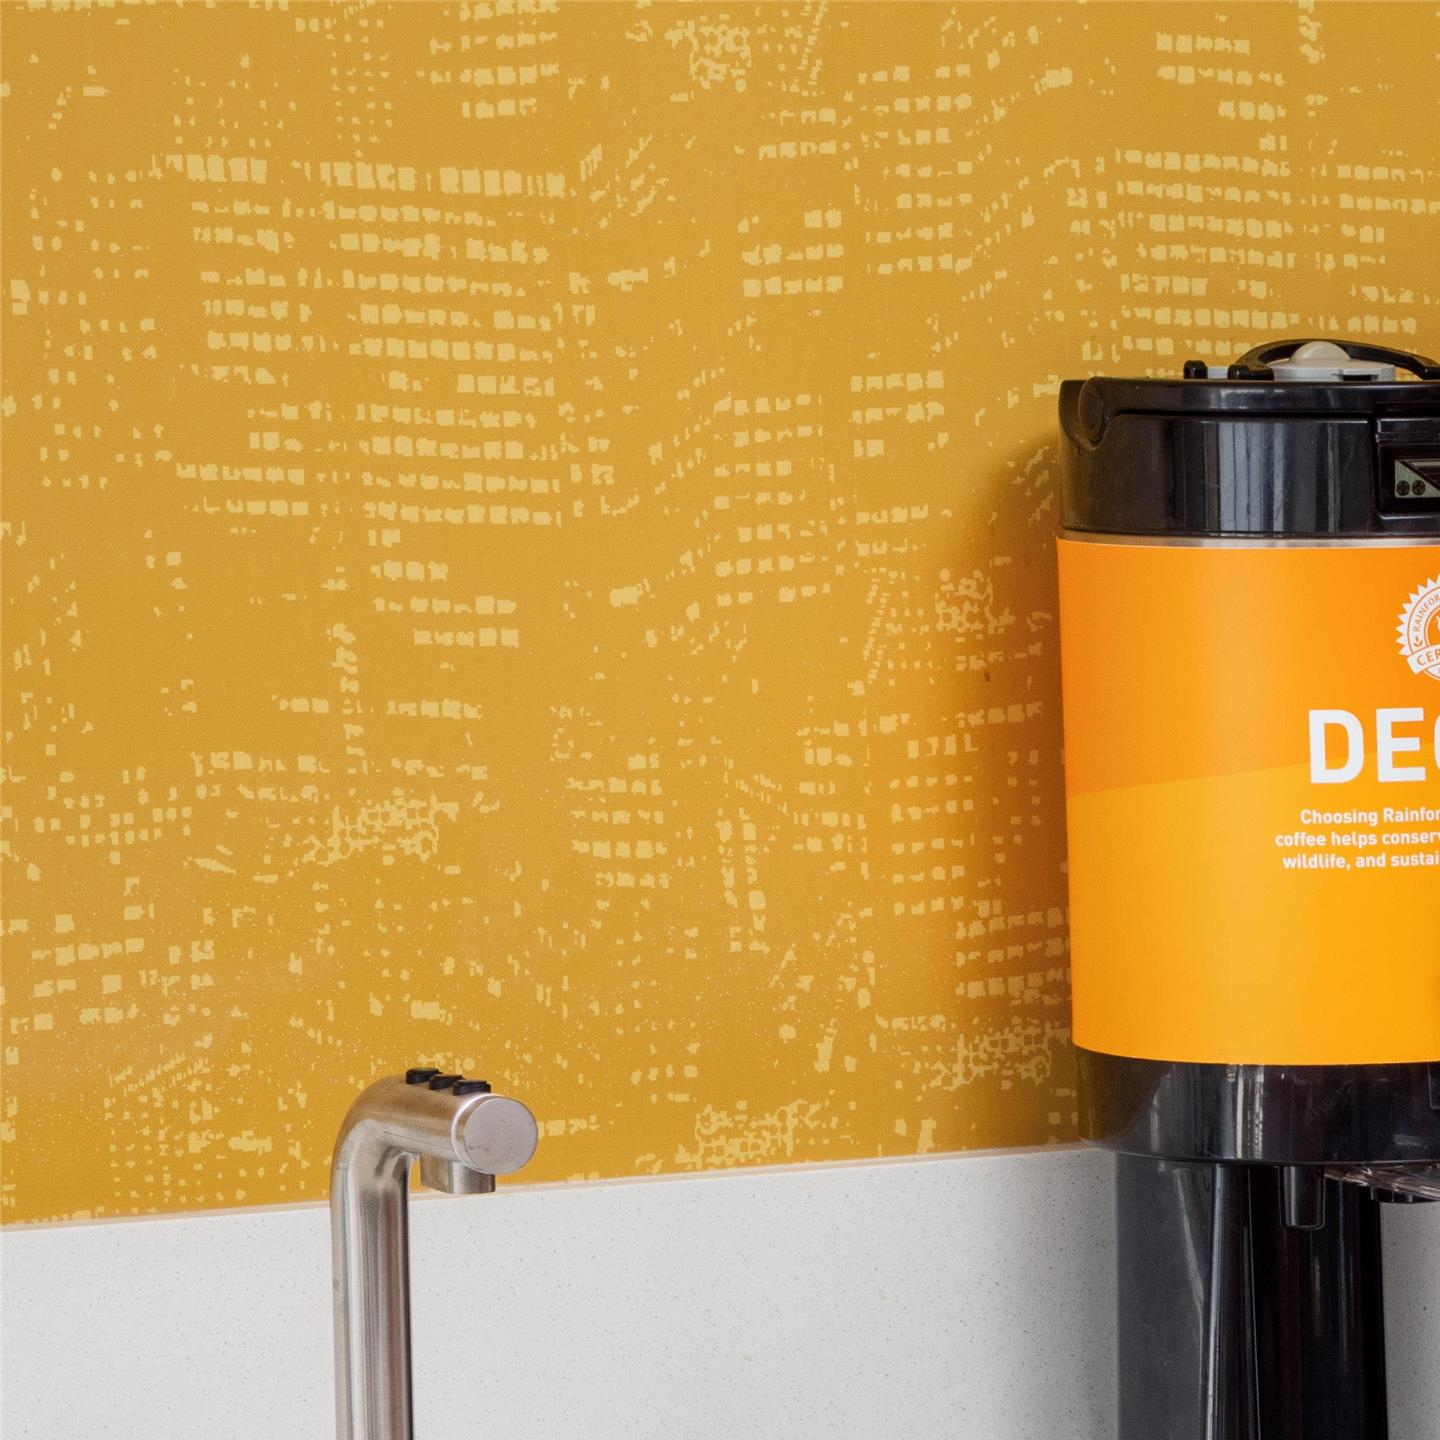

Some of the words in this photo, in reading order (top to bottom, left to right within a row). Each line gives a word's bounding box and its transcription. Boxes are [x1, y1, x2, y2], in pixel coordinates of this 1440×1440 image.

[1300, 808, 1378, 827] Choosing
[1275, 831, 1326, 847] coffee
[1331, 831, 1378, 849] helps
[1282, 852, 1351, 871] wildlife,
[1355, 852, 1386, 869] and
